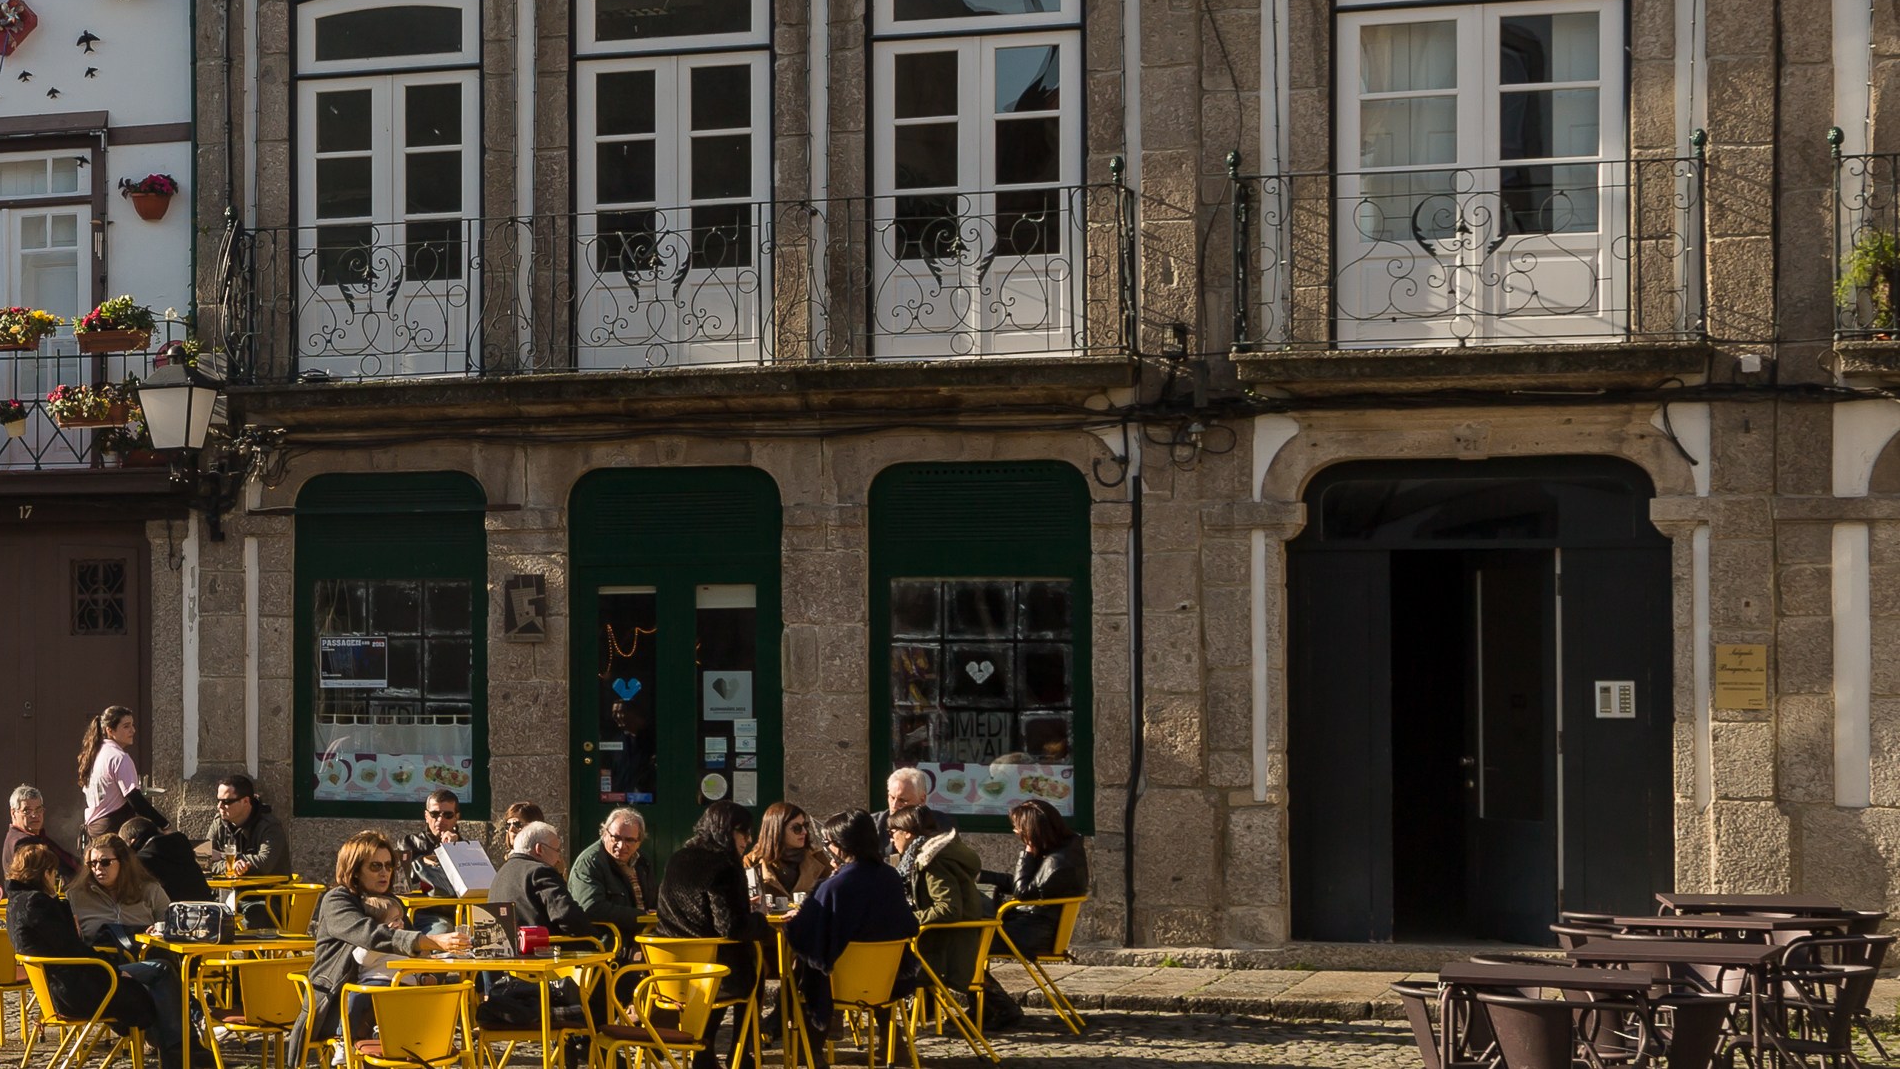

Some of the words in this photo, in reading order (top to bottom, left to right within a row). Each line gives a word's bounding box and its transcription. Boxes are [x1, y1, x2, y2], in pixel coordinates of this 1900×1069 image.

[19, 506, 32, 519] 17
[322, 639, 361, 647] PASSAGEM
[955, 712, 1008, 737] MEDI
